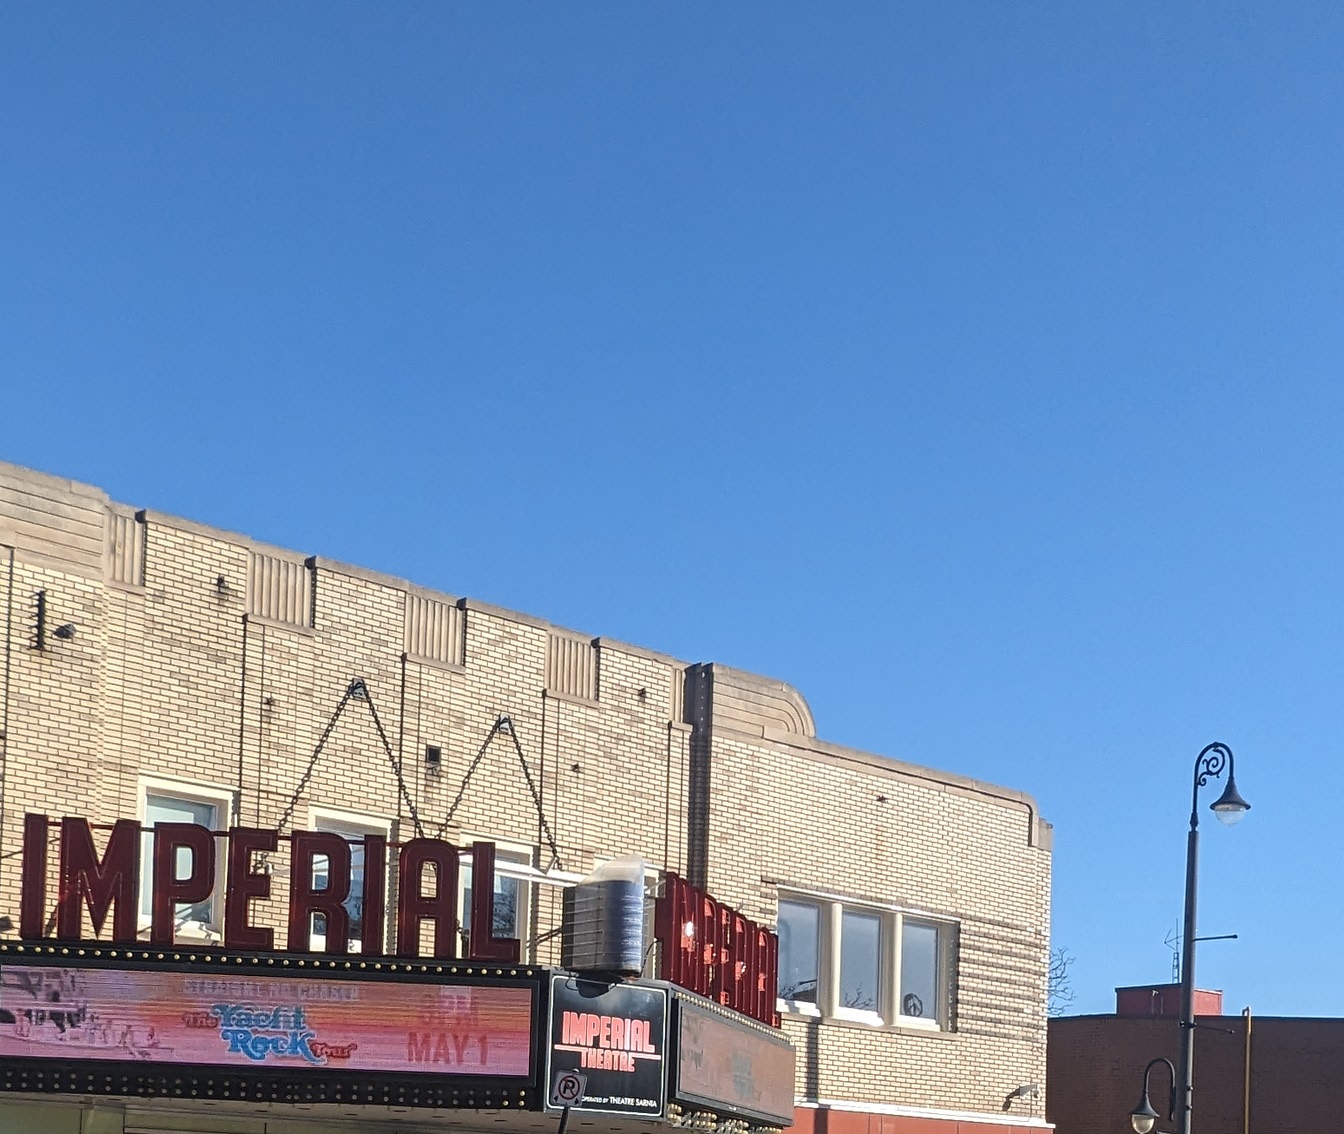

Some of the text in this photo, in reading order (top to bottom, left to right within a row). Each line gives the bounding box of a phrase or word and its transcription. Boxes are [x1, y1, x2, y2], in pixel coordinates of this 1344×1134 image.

[20, 813, 521, 962] IMPERIAL
[211, 1002, 308, 1029] Yacht
[220, 1028, 328, 1066] Rock
[407, 1032, 489, 1065] MAY 1
[562, 1011, 656, 1054] IMPERIAL
[581, 1047, 636, 1073] THEATRE
[581, 1095, 603, 1103] OPERATED
[609, 1096, 635, 1106] THEATRE
[635, 1097, 658, 1107] SARNIA
